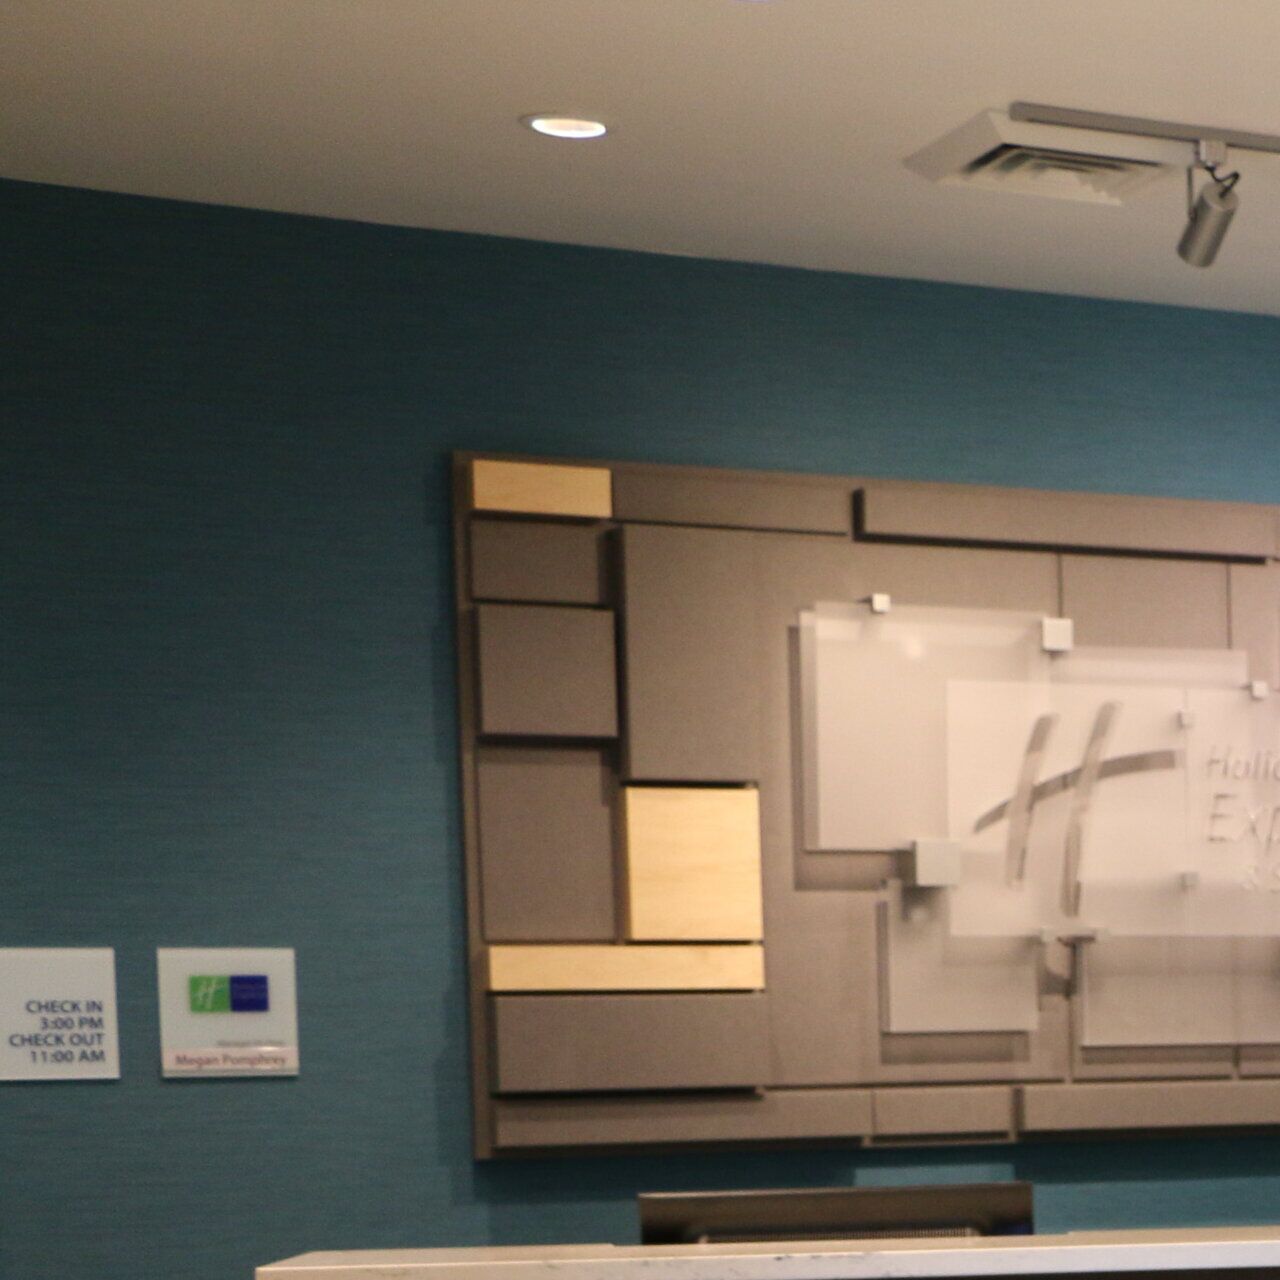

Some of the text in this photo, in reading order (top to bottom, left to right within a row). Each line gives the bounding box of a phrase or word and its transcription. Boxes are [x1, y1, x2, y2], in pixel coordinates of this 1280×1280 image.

[26, 1000, 103, 1013] CHECK IN
[41, 1016, 104, 1030] 3:00 PM
[9, 1033, 105, 1047] CHECK OUT
[30, 1049, 105, 1063] 11:00 AM
